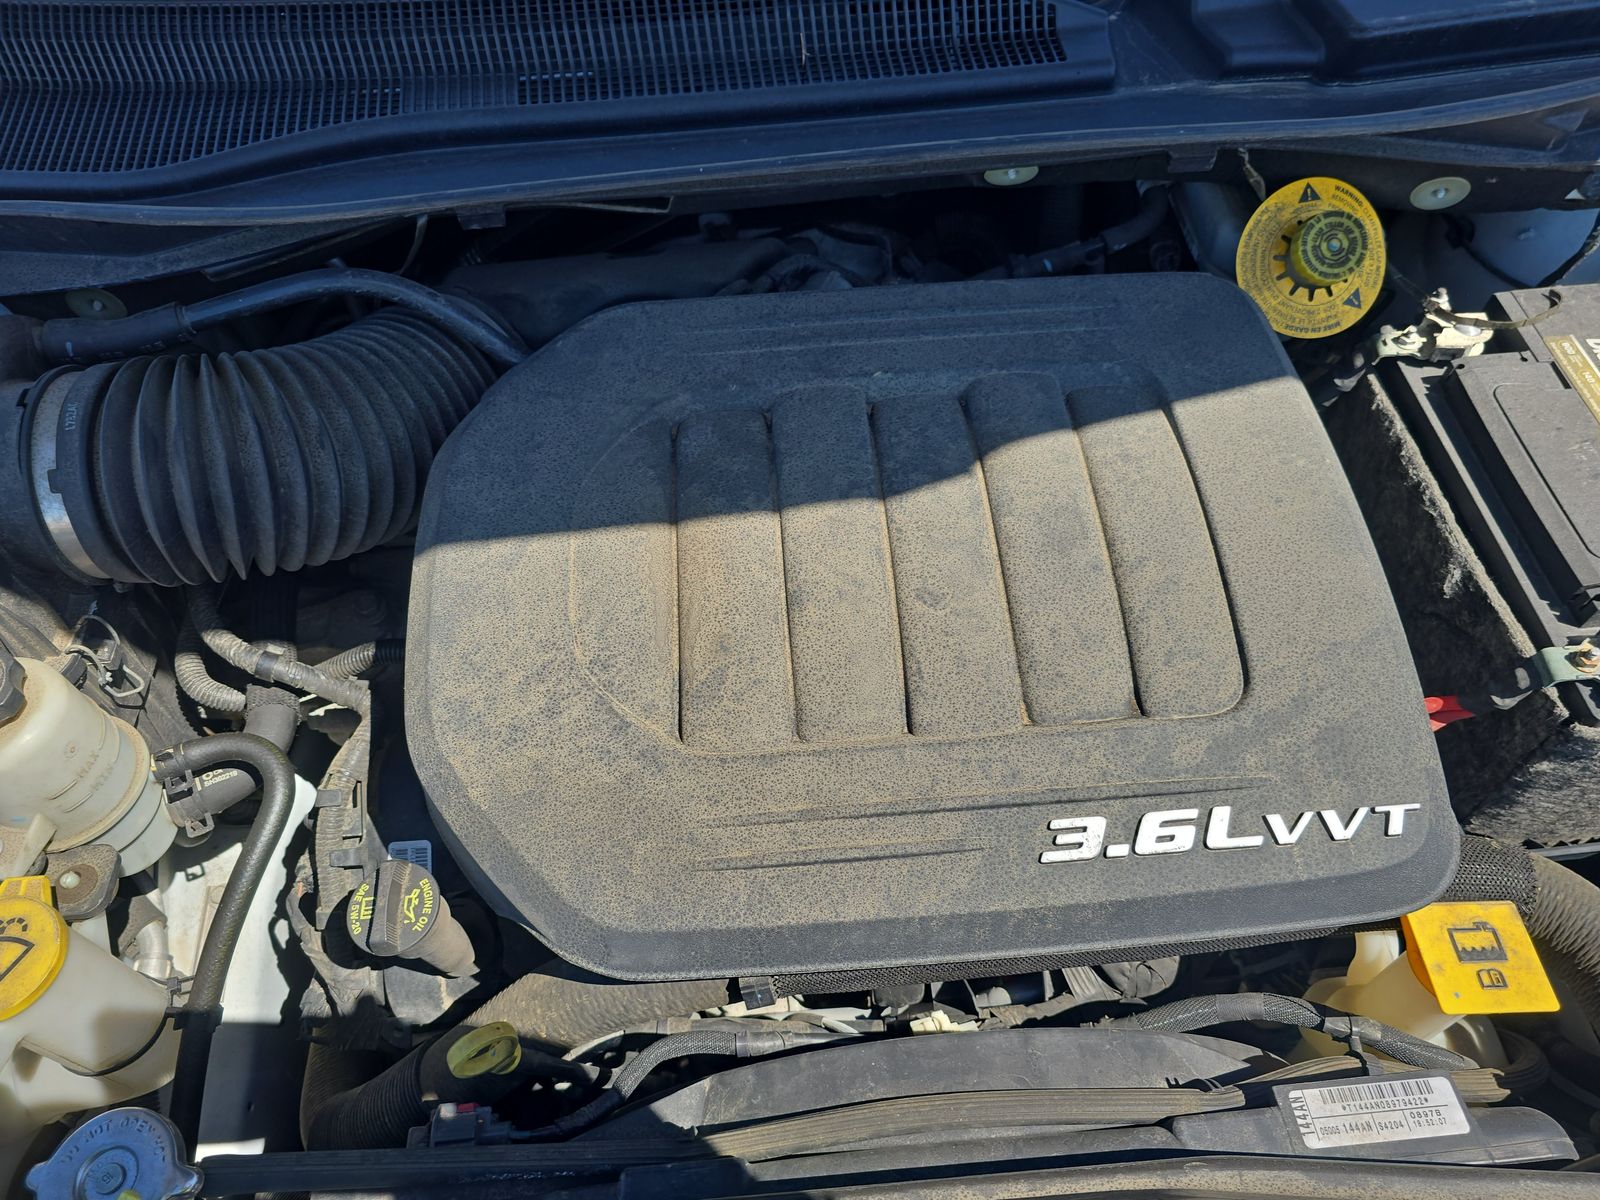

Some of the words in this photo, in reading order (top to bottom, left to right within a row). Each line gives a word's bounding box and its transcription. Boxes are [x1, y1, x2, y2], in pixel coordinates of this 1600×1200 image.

[353, 883, 370, 902] SAE
[419, 878, 434, 915] ENGINE
[350, 905, 363, 936] 5W-20
[412, 918, 429, 932] OIL
[1289, 1096, 1316, 1137] 144AN
[1342, 1121, 1374, 1134] 144AN
[1378, 1121, 1404, 1131] S4204
